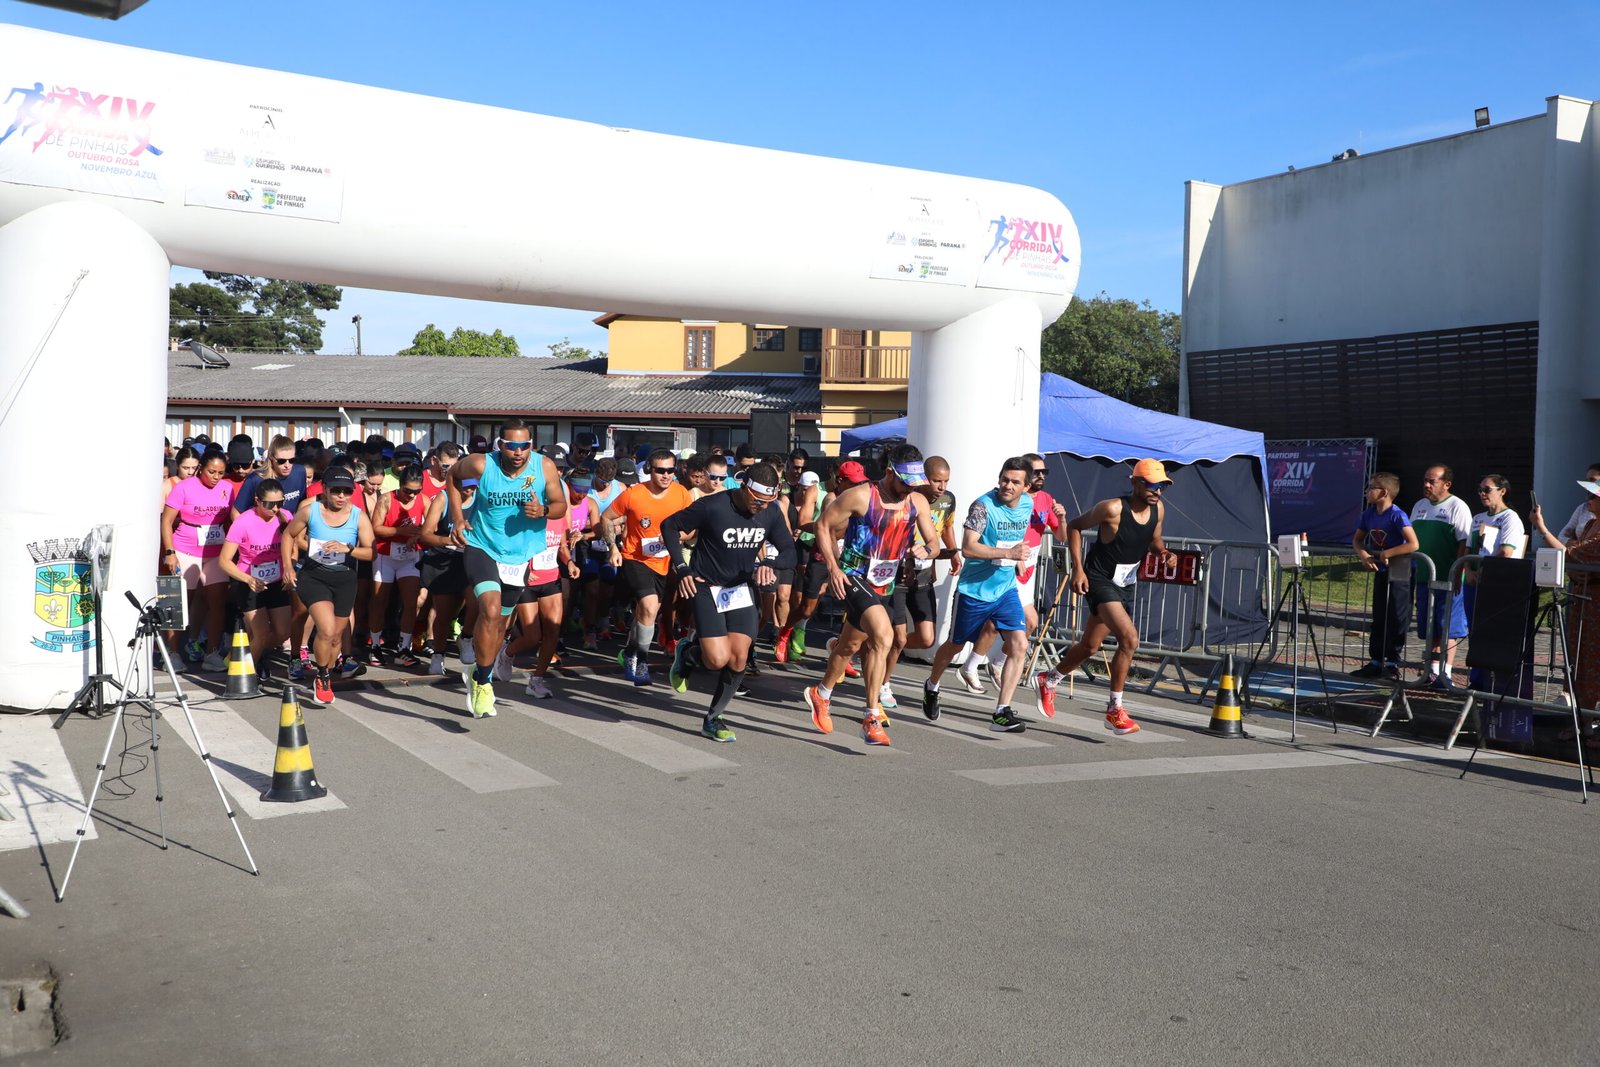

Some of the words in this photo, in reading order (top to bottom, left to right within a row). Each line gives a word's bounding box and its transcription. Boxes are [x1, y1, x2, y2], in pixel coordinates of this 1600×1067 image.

[80, 91, 156, 121] XIV
[45, 132, 65, 147] DE
[70, 135, 128, 156] PINHAIS
[67, 150, 113, 163] OUTUBRO
[115, 156, 140, 167] ROSA
[80, 162, 133, 177] NOVEMBRO
[134, 170, 158, 180] AZUL
[276, 193, 306, 203] PREFEITURA
[284, 201, 304, 209] PINHAIS
[1024, 219, 1063, 242] XIV
[1009, 239, 1053, 254] CORRIDA
[1284, 462, 1316, 479] XIV
[1273, 479, 1304, 487] CORRIDA
[722, 527, 766, 543] CWB
[258, 567, 276, 578] 022
[502, 565, 519, 577] 200
[872, 567, 894, 577] 582
[51, 634, 85, 643] PINHAIS
